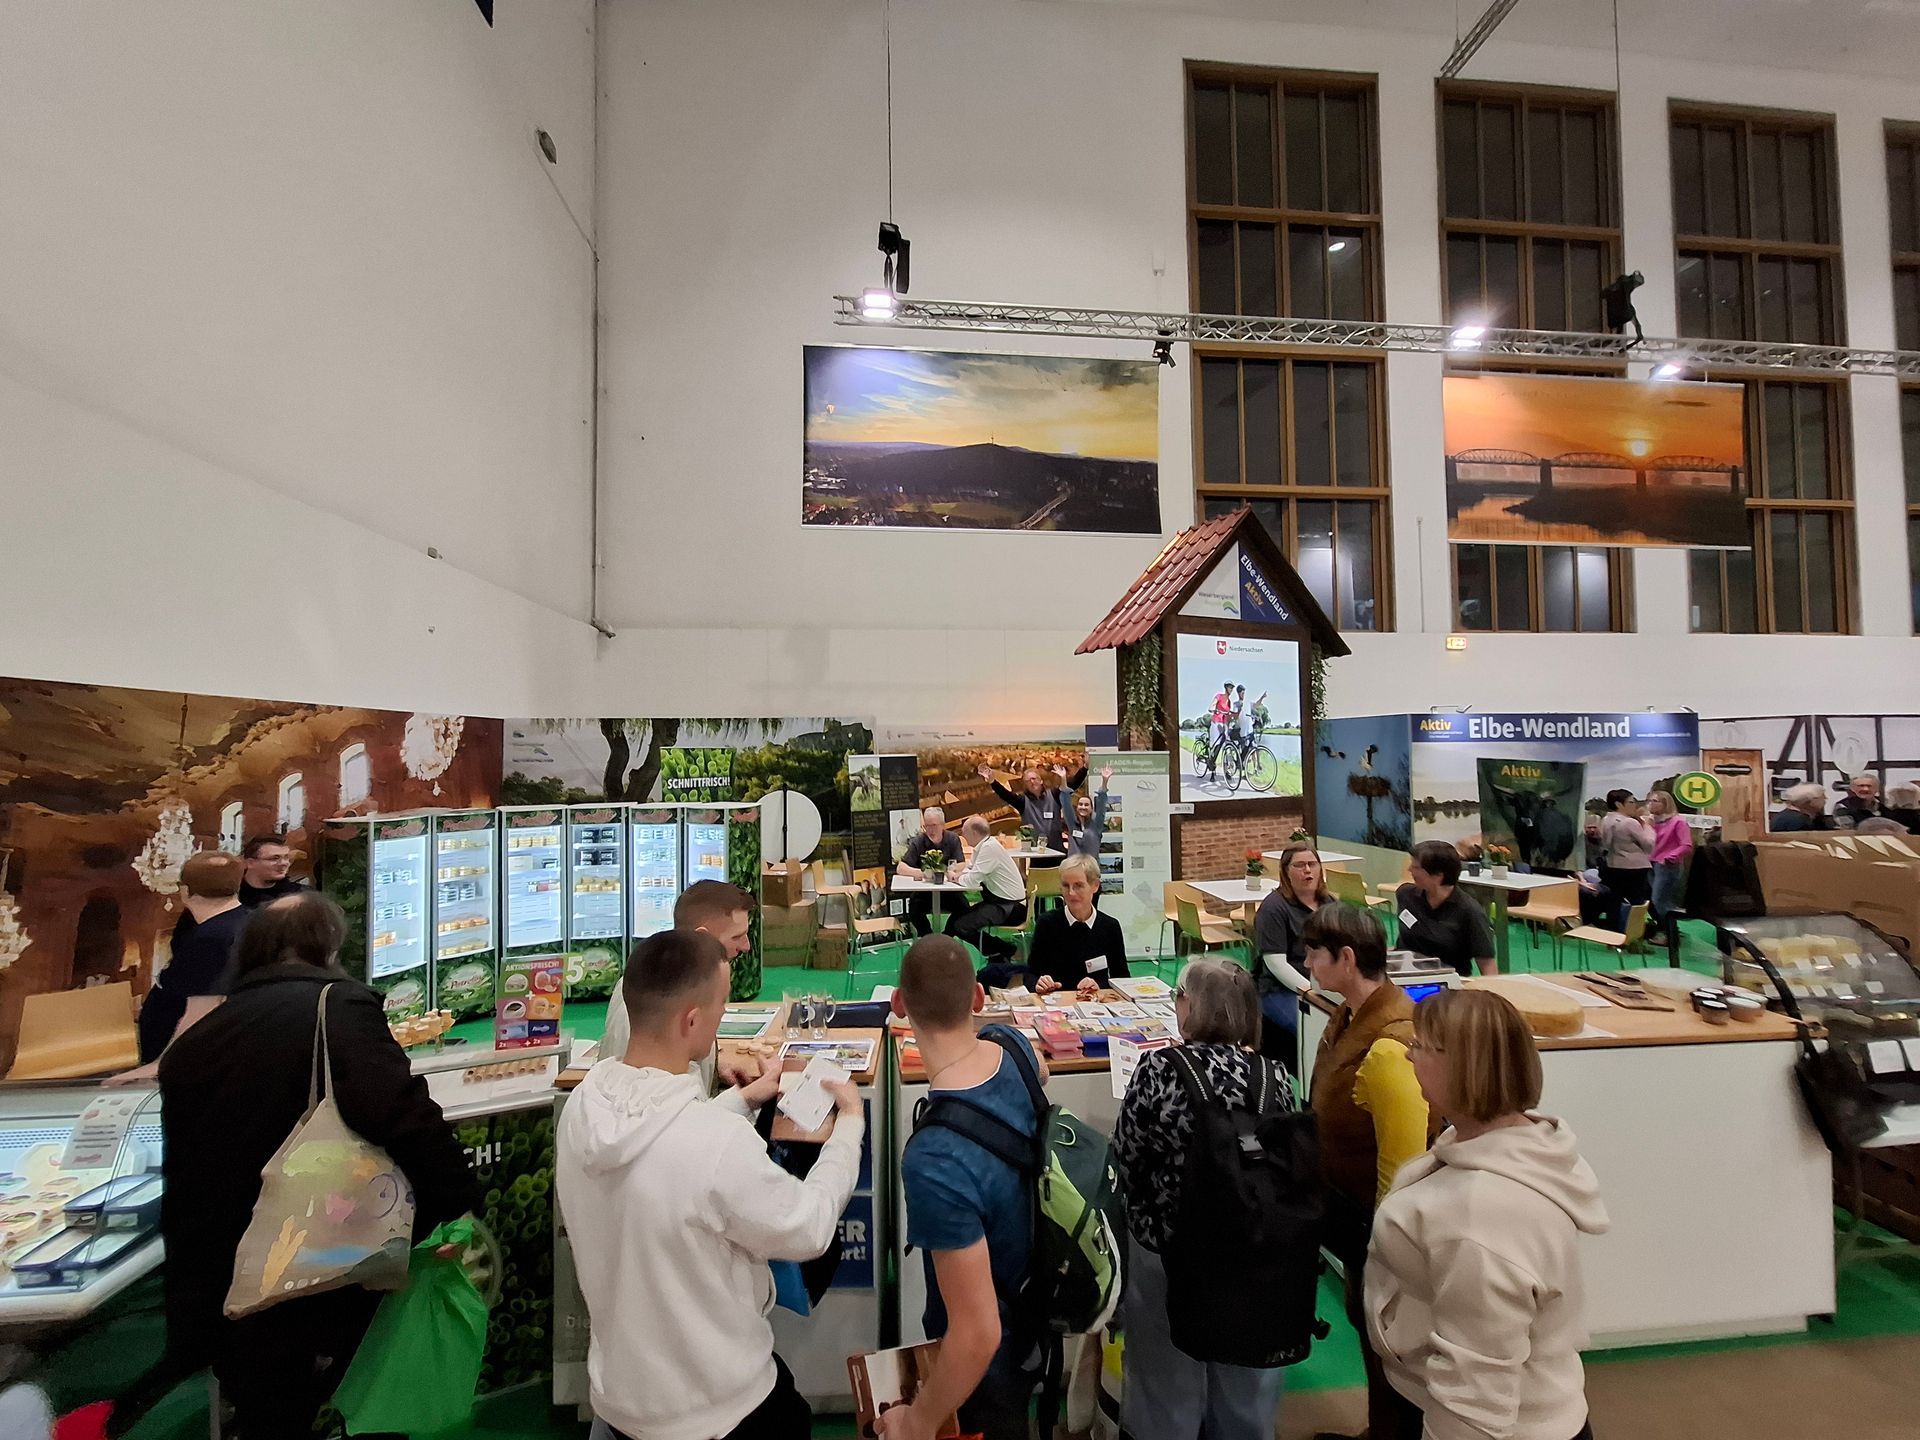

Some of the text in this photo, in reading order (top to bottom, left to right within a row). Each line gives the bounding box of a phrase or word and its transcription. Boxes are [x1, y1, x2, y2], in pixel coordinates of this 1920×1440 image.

[1240, 554, 1289, 621] Elbe-Wendland
[1420, 718, 1452, 731] Aktiv
[1468, 716, 1630, 739] Elbe-Wendland
[1501, 764, 1541, 777] Aktiv
[667, 777, 731, 790] SCHNITTFRISCH!
[1687, 781, 1708, 799] H
